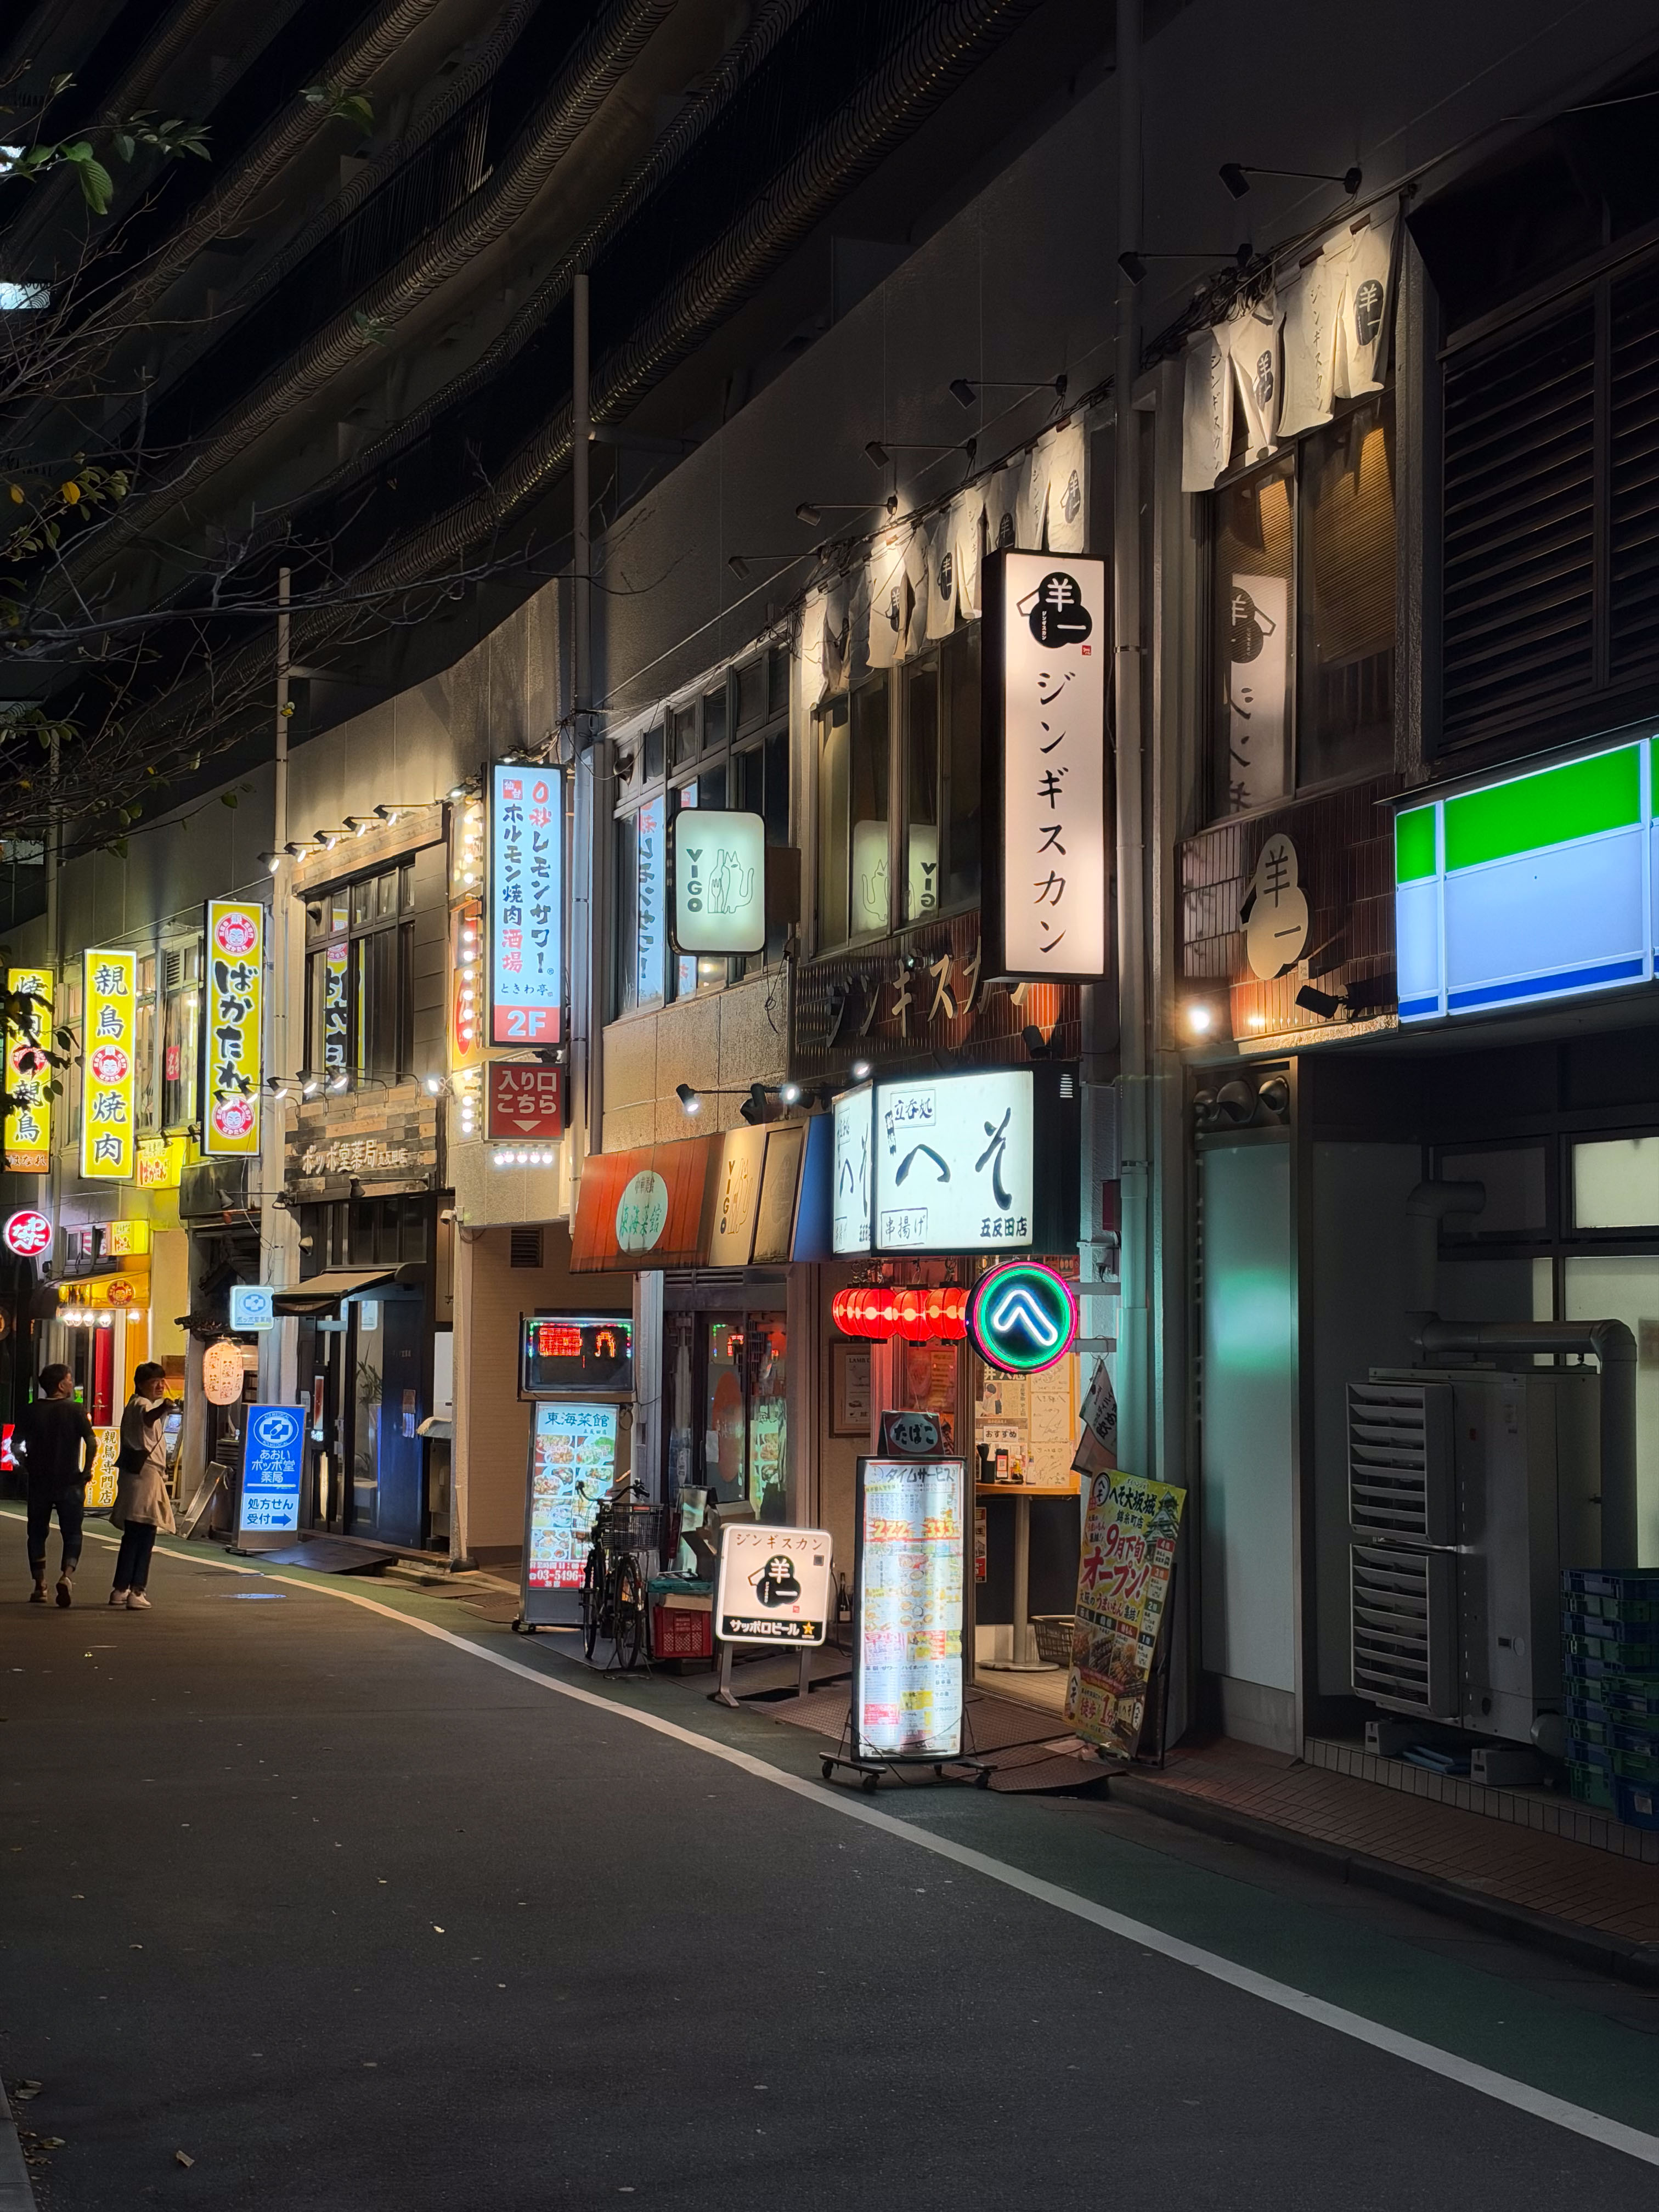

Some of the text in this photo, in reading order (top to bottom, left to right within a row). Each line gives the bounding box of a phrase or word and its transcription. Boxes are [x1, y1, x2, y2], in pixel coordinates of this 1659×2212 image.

[1045, 578, 1087, 630] 羊一
[1033, 670, 1076, 954] ジンギスカン
[502, 803, 523, 973] ホルモン焼肉酒場
[686, 848, 703, 913] VIGO
[1263, 845, 1301, 938] 羊一
[93, 964, 128, 1039] 親鳥
[500, 983, 549, 996] ときわ亭
[214, 960, 259, 1090] ばかたれ
[507, 1010, 547, 1037] 2F
[497, 1070, 557, 1092] 入り口
[496, 1093, 557, 1115] こちら
[92, 1091, 128, 1165] 焼肉
[895, 1107, 1013, 1211] へそ
[720, 1160, 735, 1235] VIGO
[885, 1214, 926, 1242] 串揚げ
[979, 1216, 1028, 1238] 五反田店
[545, 1412, 610, 1427] 東海菜館
[893, 1423, 935, 1445] たばこ
[985, 1430, 1017, 1438] おすすめ
[99, 1430, 116, 1504] 親鳥専門店
[251, 1459, 296, 1472] ポッポ堂
[259, 1449, 291, 1460] あおい
[261, 1471, 284, 1483] 薬局
[885, 1466, 955, 1483] タイムサービス
[247, 1498, 294, 1510] 処方せん
[247, 1513, 271, 1525] 受付
[736, 1533, 823, 1551] ジンギスカン
[1104, 1523, 1145, 1564] 9月下旬
[768, 1558, 798, 1596] 羊一
[1080, 1545, 1150, 1600] オープン!
[730, 1619, 800, 1636] サッポロビール
